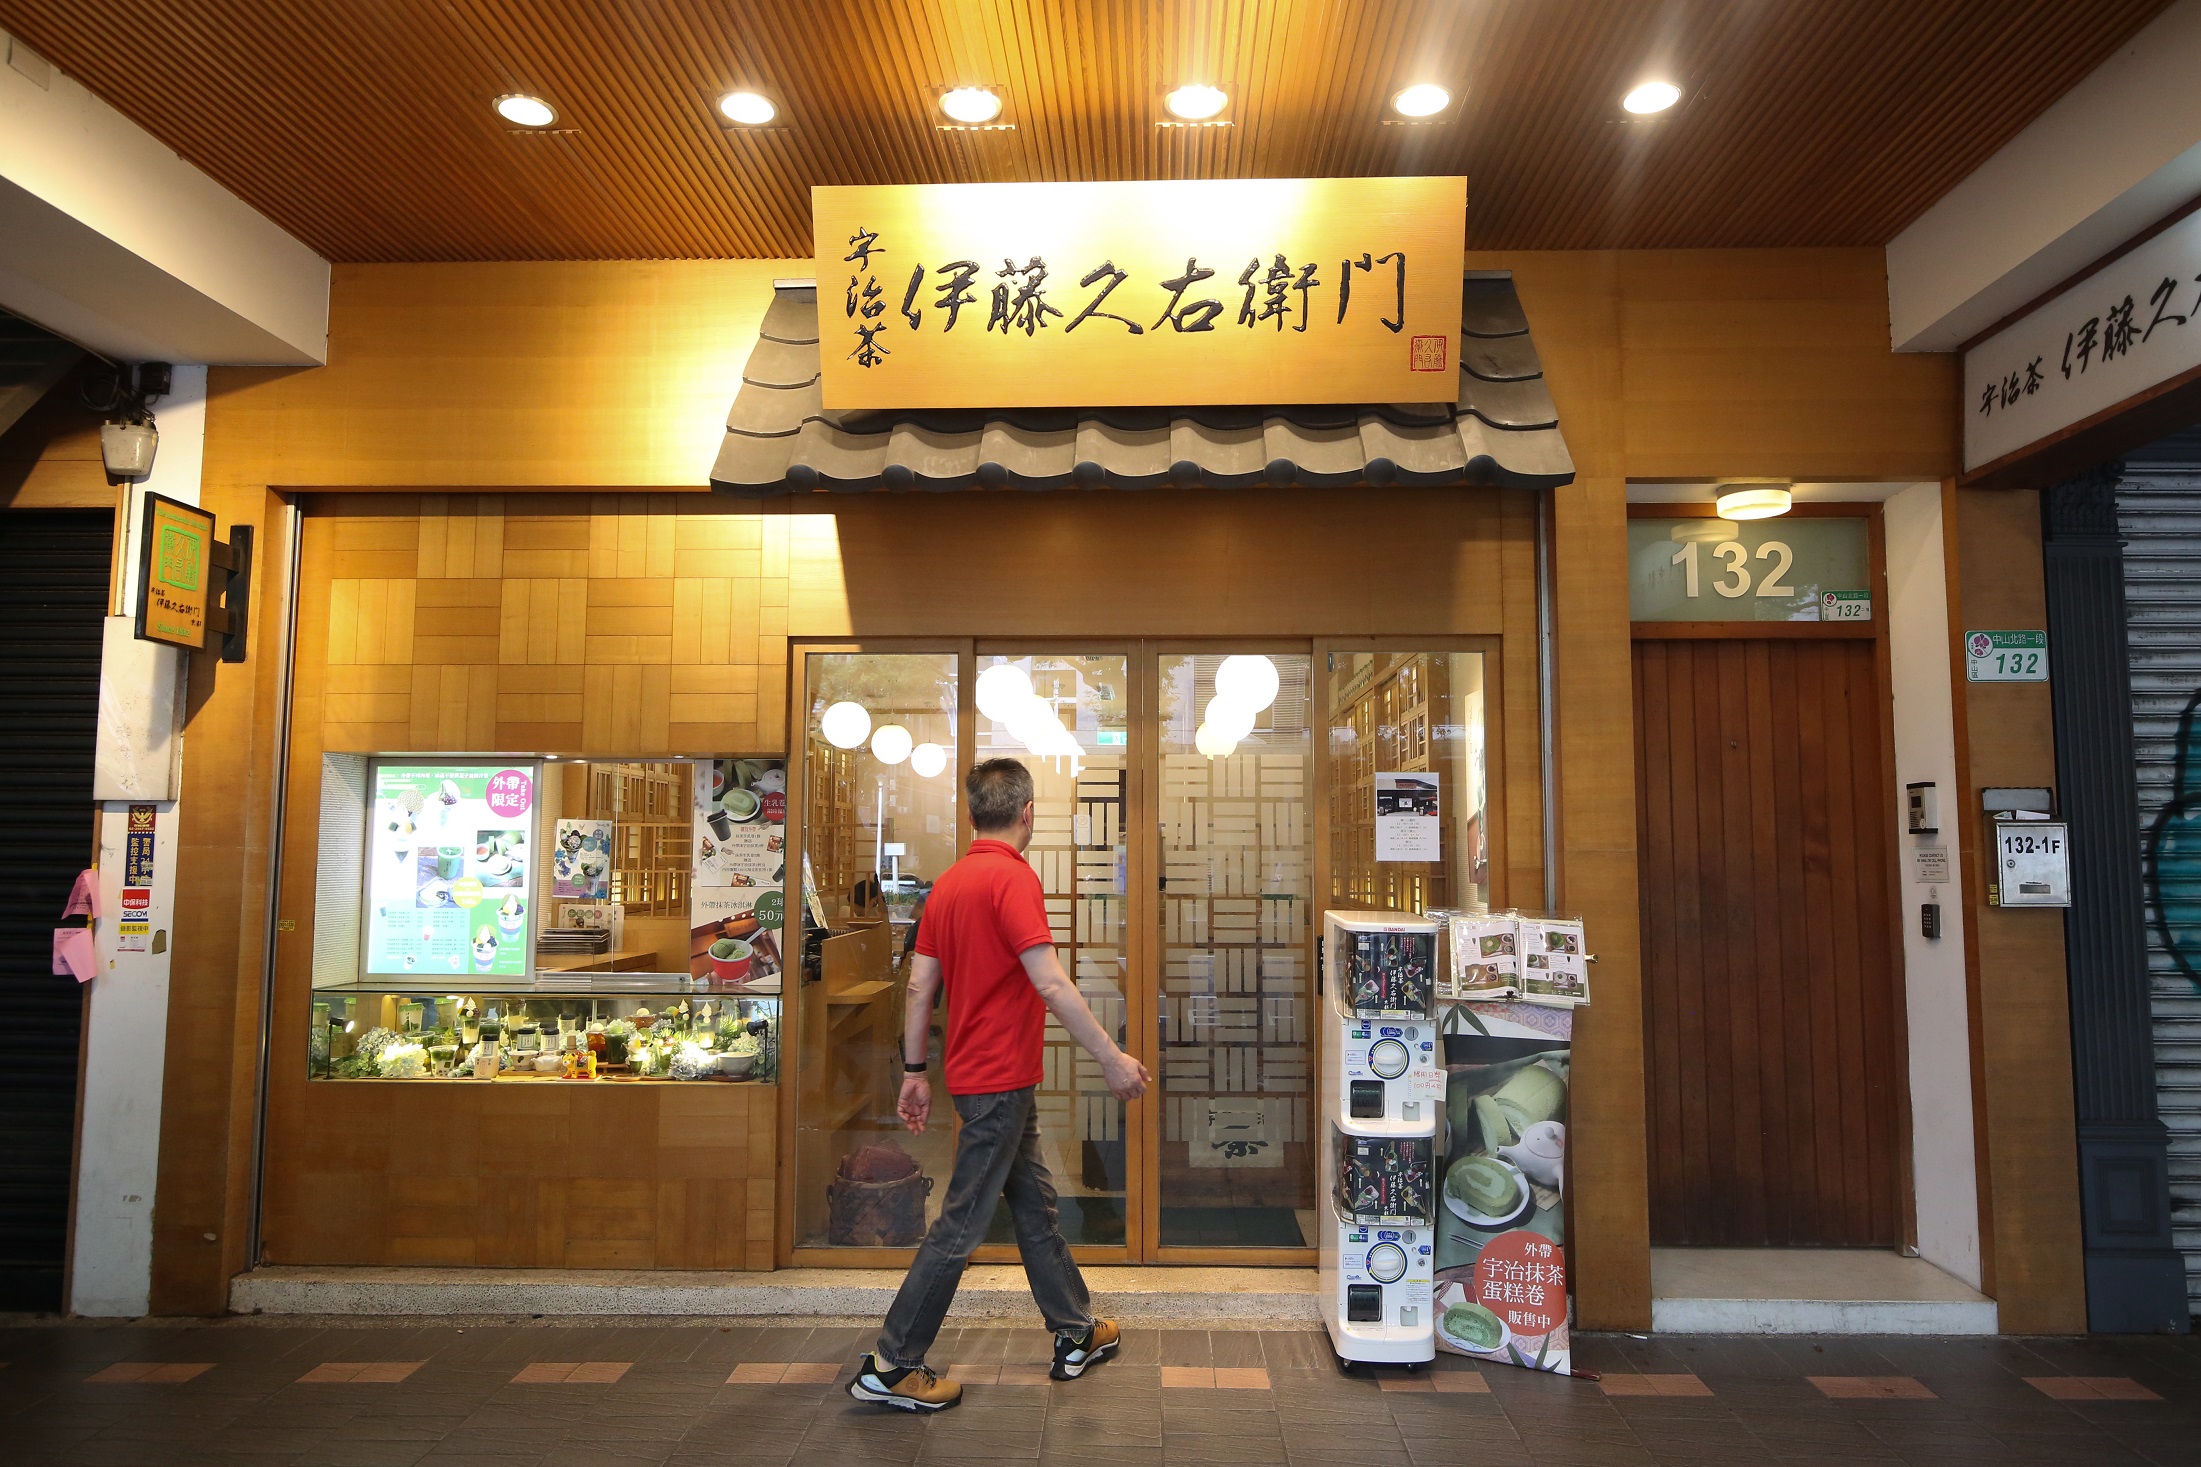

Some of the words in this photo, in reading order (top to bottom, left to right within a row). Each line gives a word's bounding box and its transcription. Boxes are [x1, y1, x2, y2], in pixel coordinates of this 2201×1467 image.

[901, 251, 1406, 335] 伊藤久右衛門
[1979, 355, 2044, 417] 宇治茶
[2060, 275, 2201, 381] 伊藤久
[1672, 541, 1795, 598] 132
[1836, 604, 1861, 617] 132
[1993, 633, 2044, 645] 中山北路一段
[1970, 659, 1979, 679] 中山區
[1995, 653, 2039, 674] 132
[492, 776, 520, 790] 外帶
[491, 793, 520, 807] 限定
[2005, 836, 2060, 854] 132-1F
[123, 898, 149, 906] 中保科技
[1525, 1242, 1553, 1258] 外帶
[1482, 1257, 1564, 1286] 宇治抹茶
[1482, 1279, 1545, 1306] 蛋糕卷
[1508, 1309, 1551, 1329] 販售中
